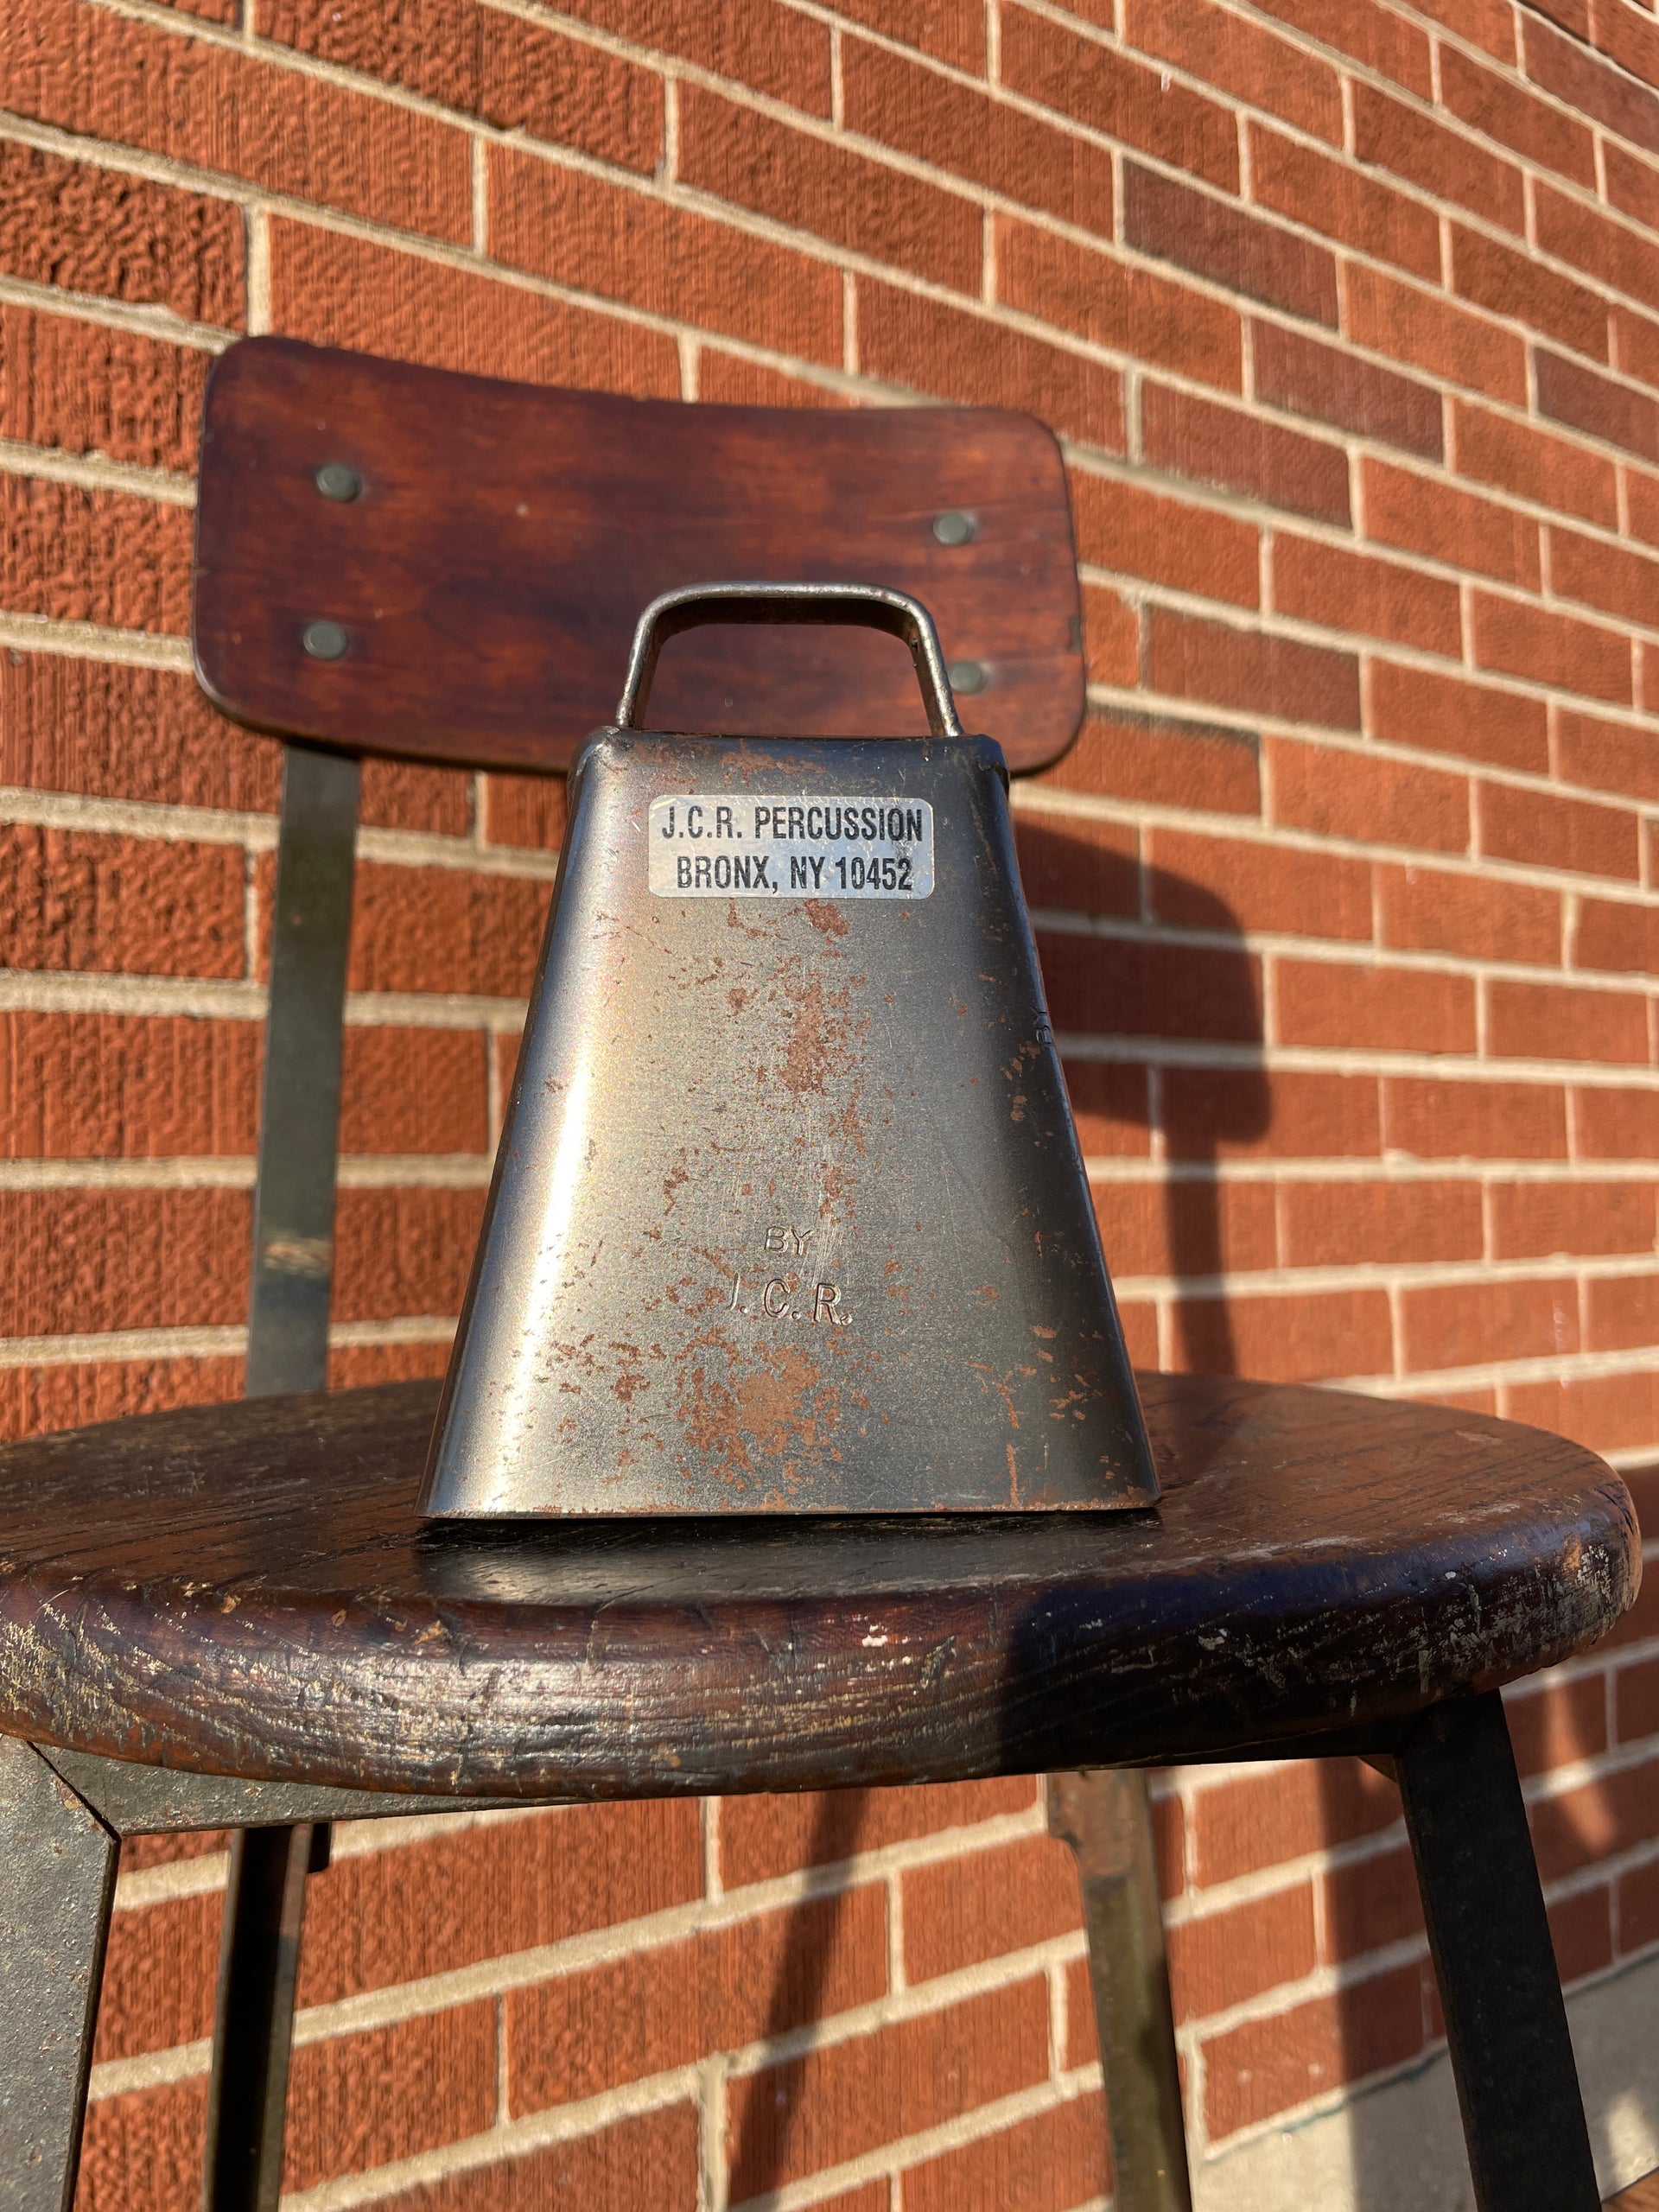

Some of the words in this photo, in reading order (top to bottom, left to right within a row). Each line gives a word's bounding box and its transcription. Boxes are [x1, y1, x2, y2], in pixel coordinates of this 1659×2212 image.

[662, 805, 742, 839] J.C.R.
[754, 806, 923, 842] PERCUSSION
[677, 855, 779, 893] BRONX,
[791, 856, 826, 889] NY
[835, 856, 912, 891] 10452
[764, 1225, 815, 1255] BY
